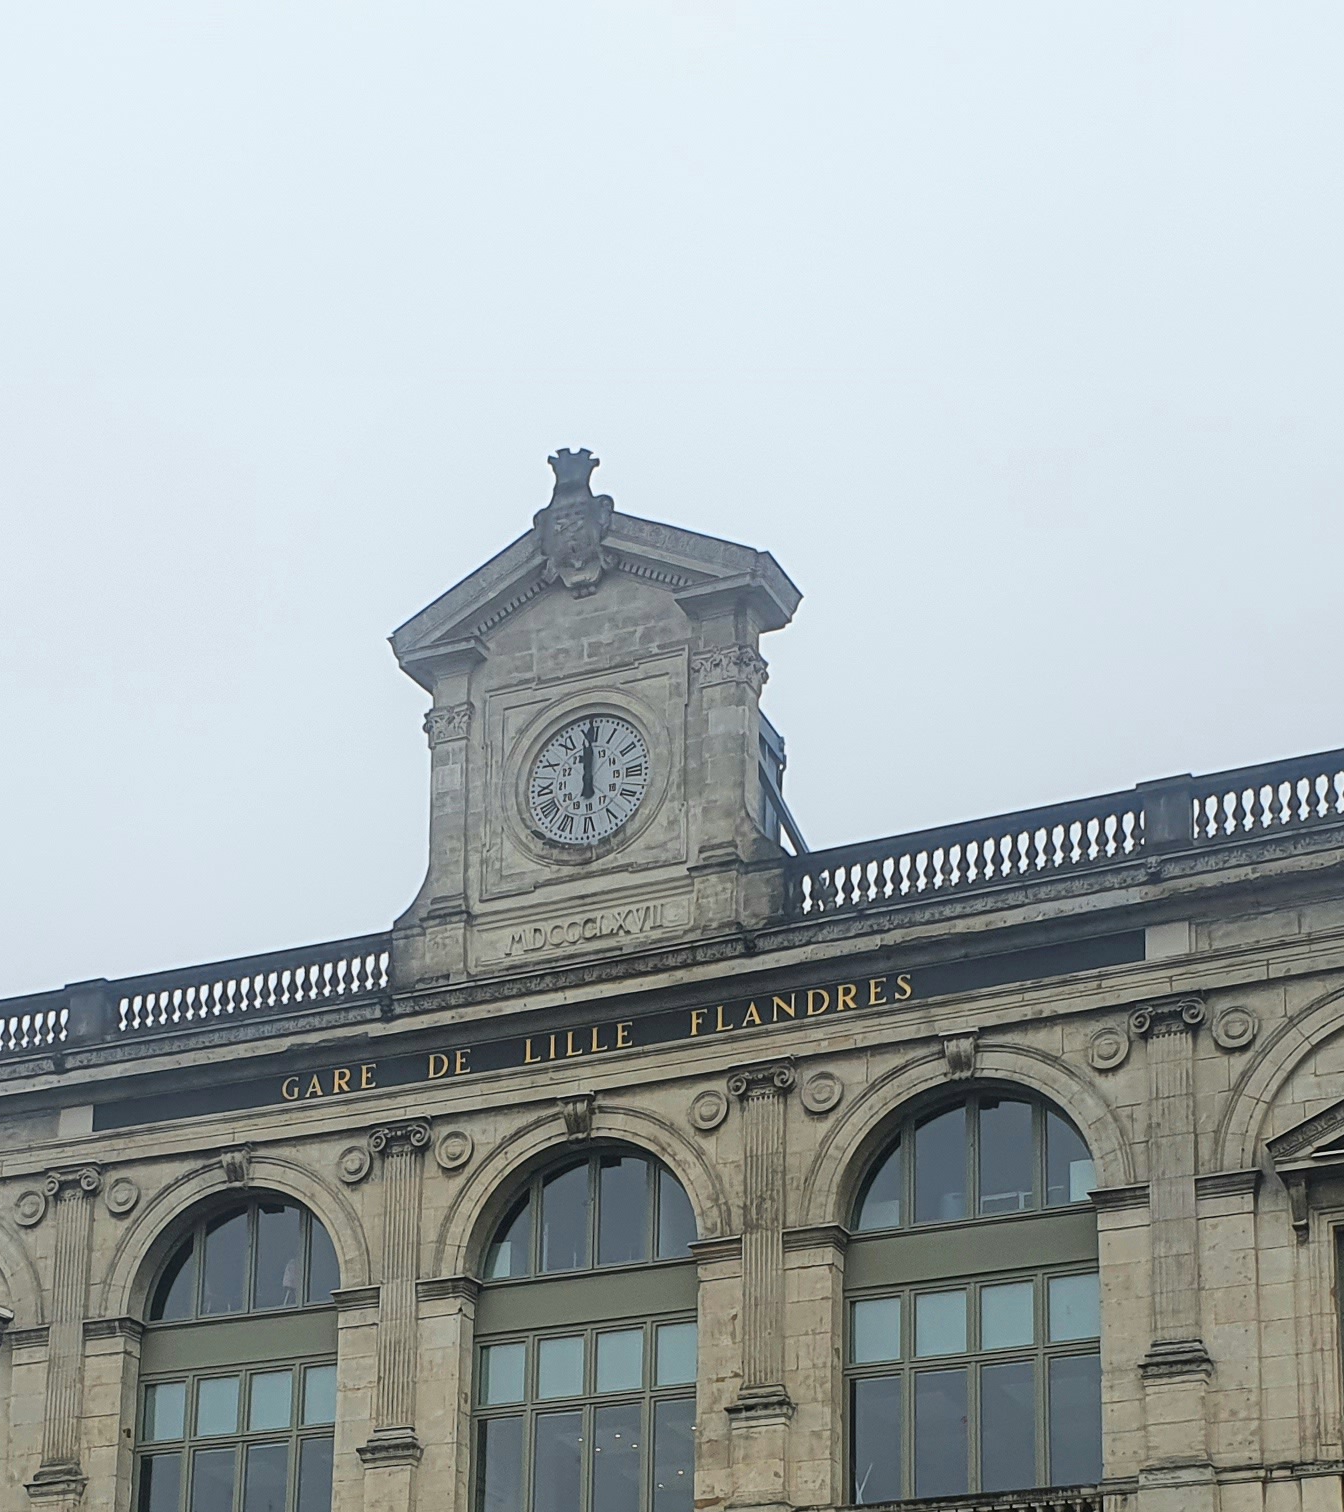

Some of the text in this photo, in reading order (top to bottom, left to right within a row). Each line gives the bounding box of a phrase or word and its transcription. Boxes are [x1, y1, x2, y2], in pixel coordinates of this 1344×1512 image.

[281, 973, 914, 1101] GARE DE LILLE FLANDRES
